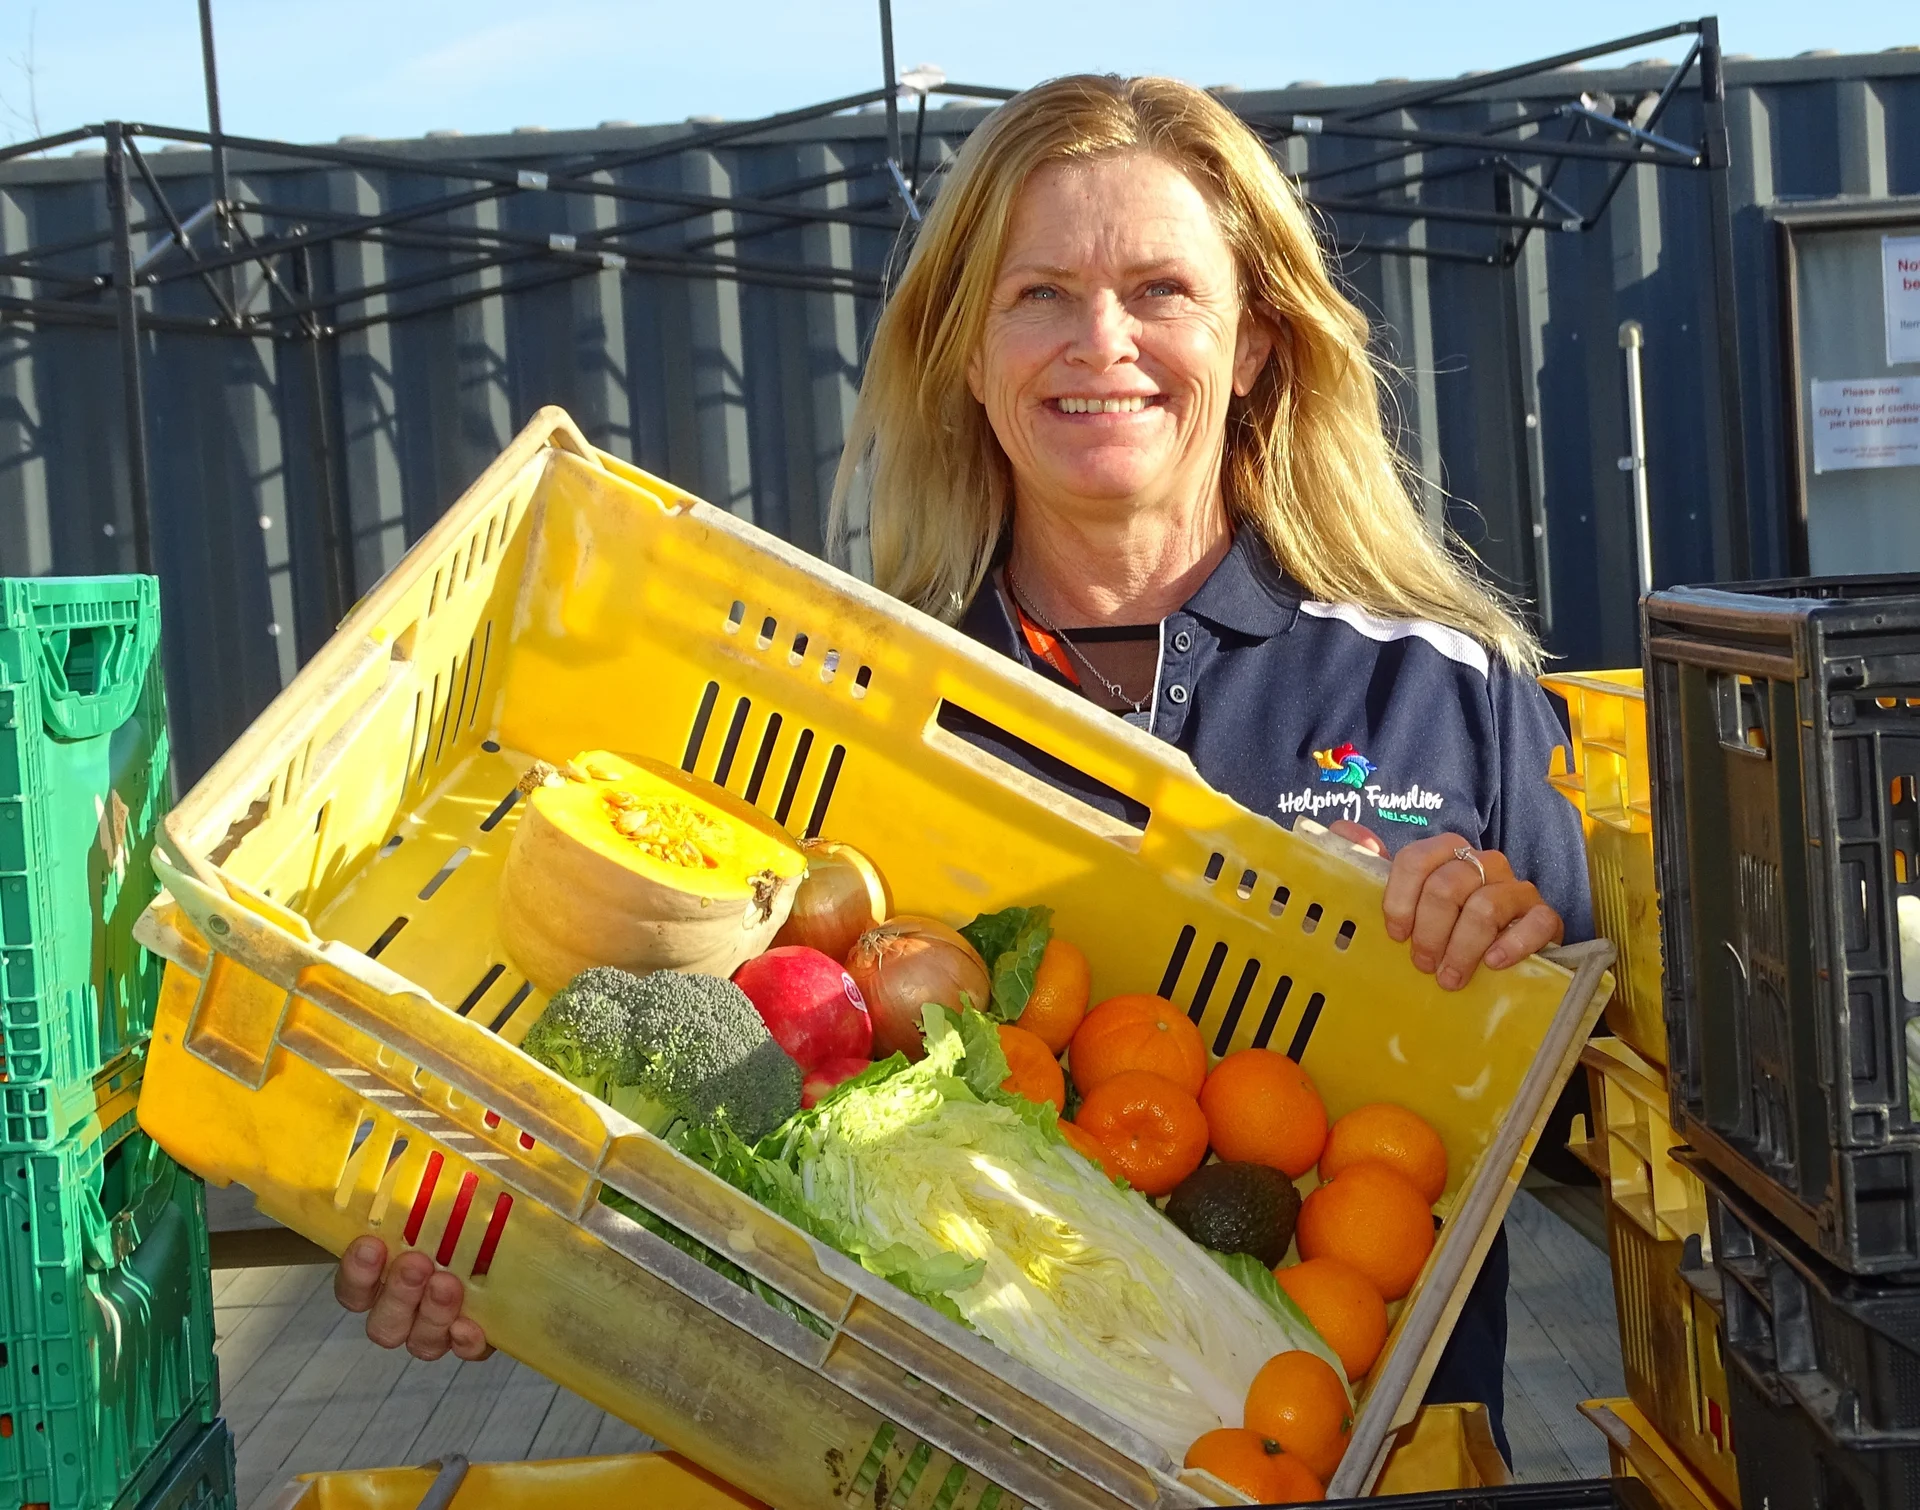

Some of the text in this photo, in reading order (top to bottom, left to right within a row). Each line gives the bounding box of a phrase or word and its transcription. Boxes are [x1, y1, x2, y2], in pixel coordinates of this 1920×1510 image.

[1898, 258, 1920, 272] No
[1842, 388, 1875, 397] Please
[1819, 407, 1841, 417] Only
[1854, 406, 1872, 415] bag
[1875, 404, 1885, 413] of
[1829, 416, 1918, 430] per person please
[1278, 784, 1444, 823] Helping Families
[1377, 808, 1428, 826] NELSON
